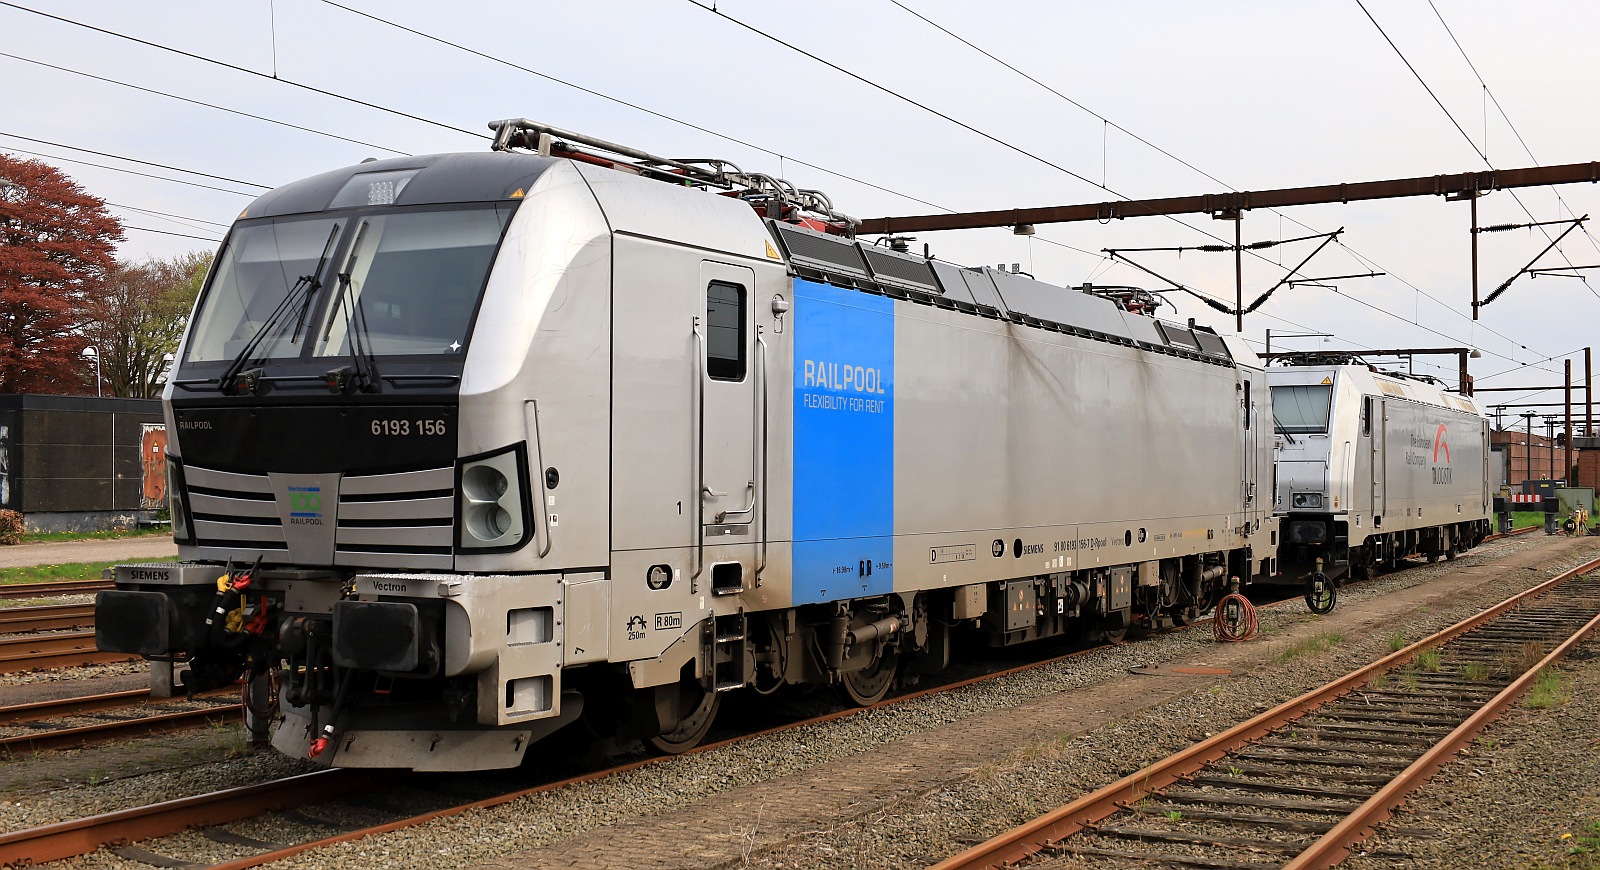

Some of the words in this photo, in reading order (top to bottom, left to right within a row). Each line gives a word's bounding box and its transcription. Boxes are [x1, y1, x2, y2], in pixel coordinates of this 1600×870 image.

[803, 359, 885, 394] RAILPOOL
[803, 393, 847, 410] FLEXIBILITY
[849, 397, 864, 412] FOR
[865, 399, 885, 414] RENT
[179, 421, 213, 430] RAILPOOL
[371, 419, 410, 436] 6193
[416, 419, 446, 435] 156
[289, 492, 321, 511] 100
[676, 500, 682, 515] 1
[1023, 544, 1044, 555] SIEMENS
[1054, 541, 1060, 552] 91
[931, 549, 937, 562] D
[130, 569, 170, 581] SIEMENS
[372, 580, 407, 592] Vectron
[656, 616, 662, 627] R
[664, 616, 680, 627] 80m
[628, 631, 646, 641] 250m
